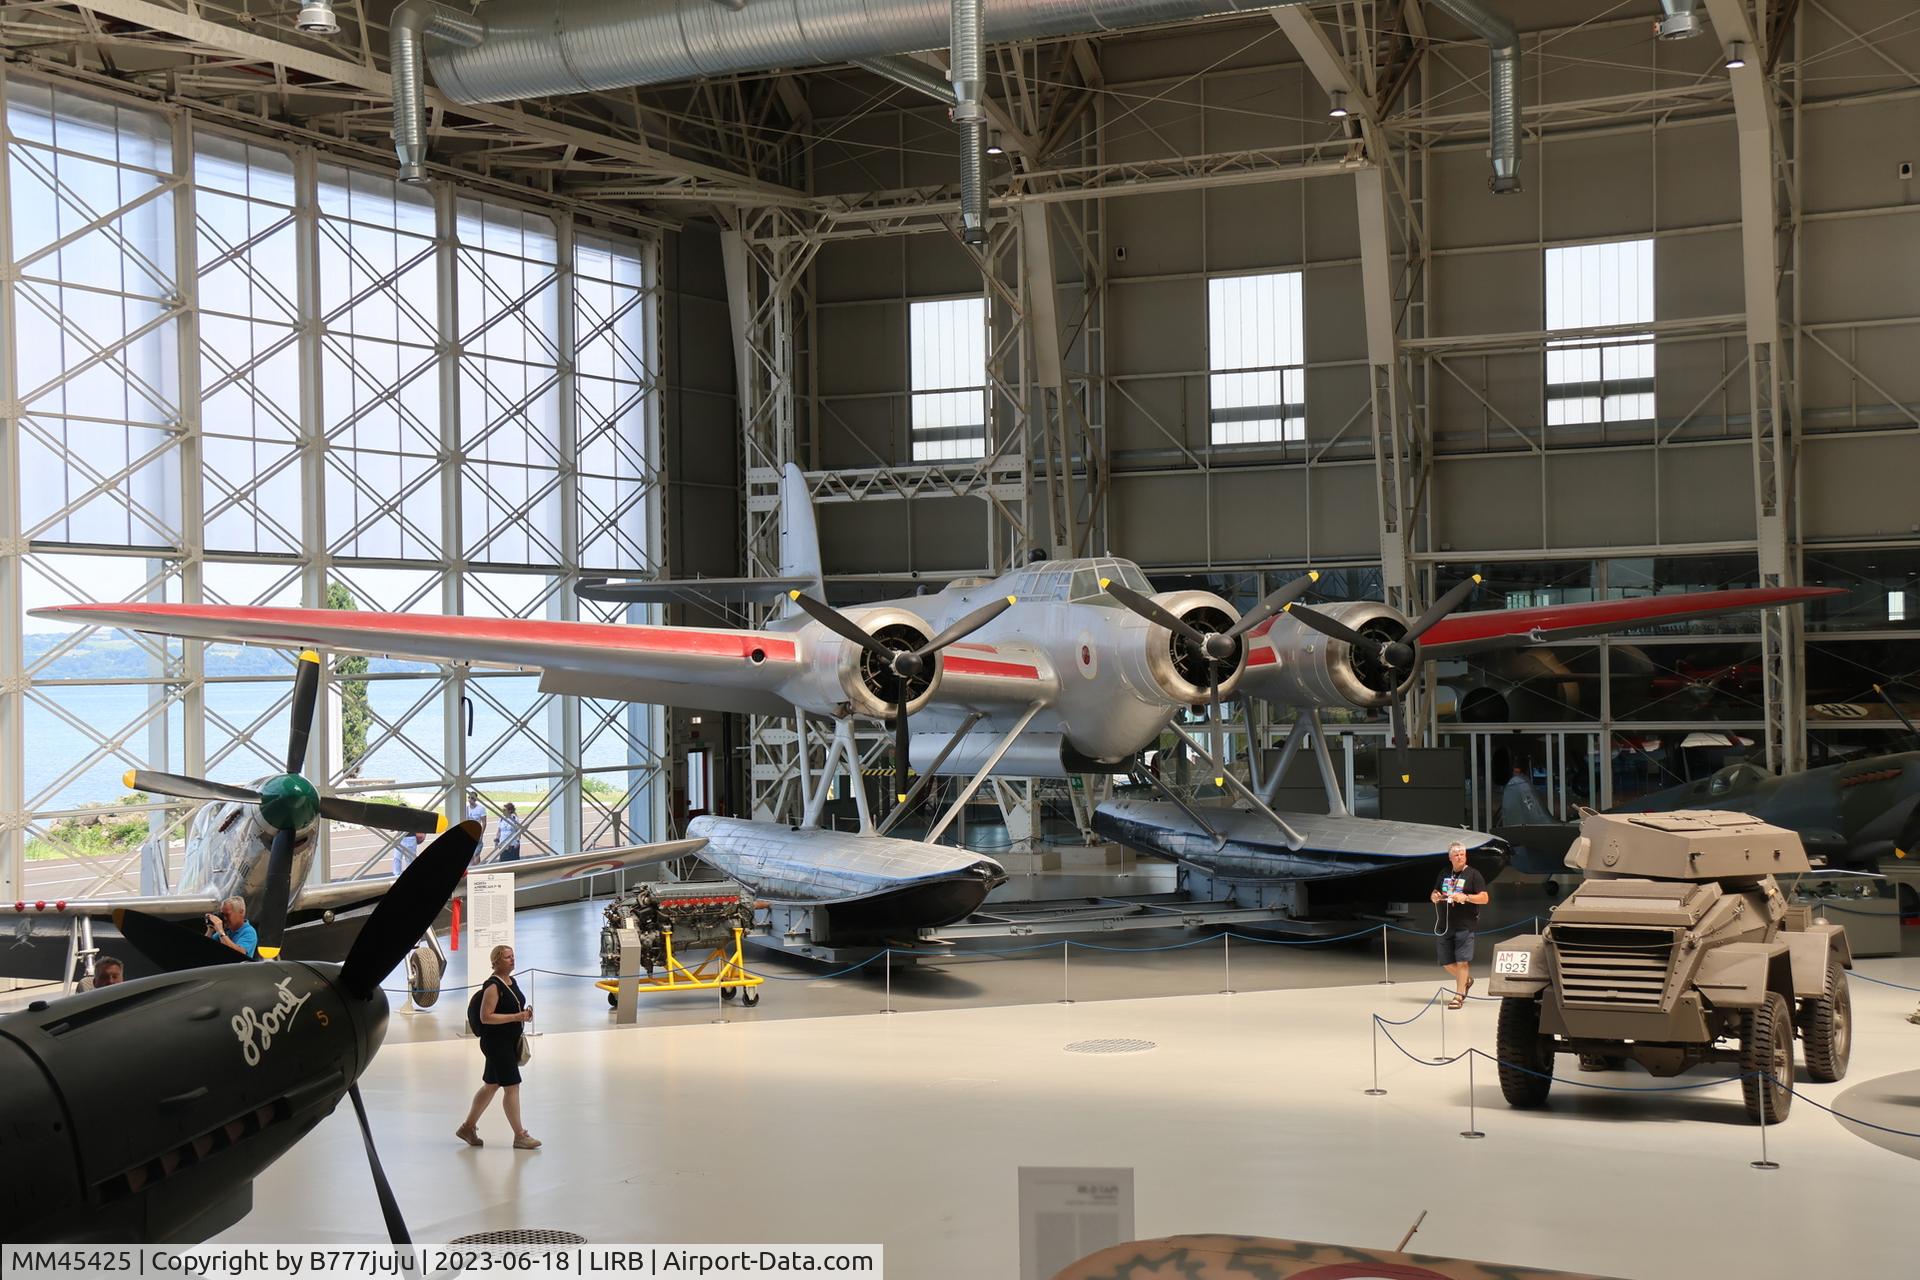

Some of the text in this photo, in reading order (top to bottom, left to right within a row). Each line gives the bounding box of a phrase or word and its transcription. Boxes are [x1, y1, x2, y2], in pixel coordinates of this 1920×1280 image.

[1499, 953, 1528, 962] AM 2
[1500, 963, 1527, 973] 1923
[315, 1010, 329, 1027] 5
